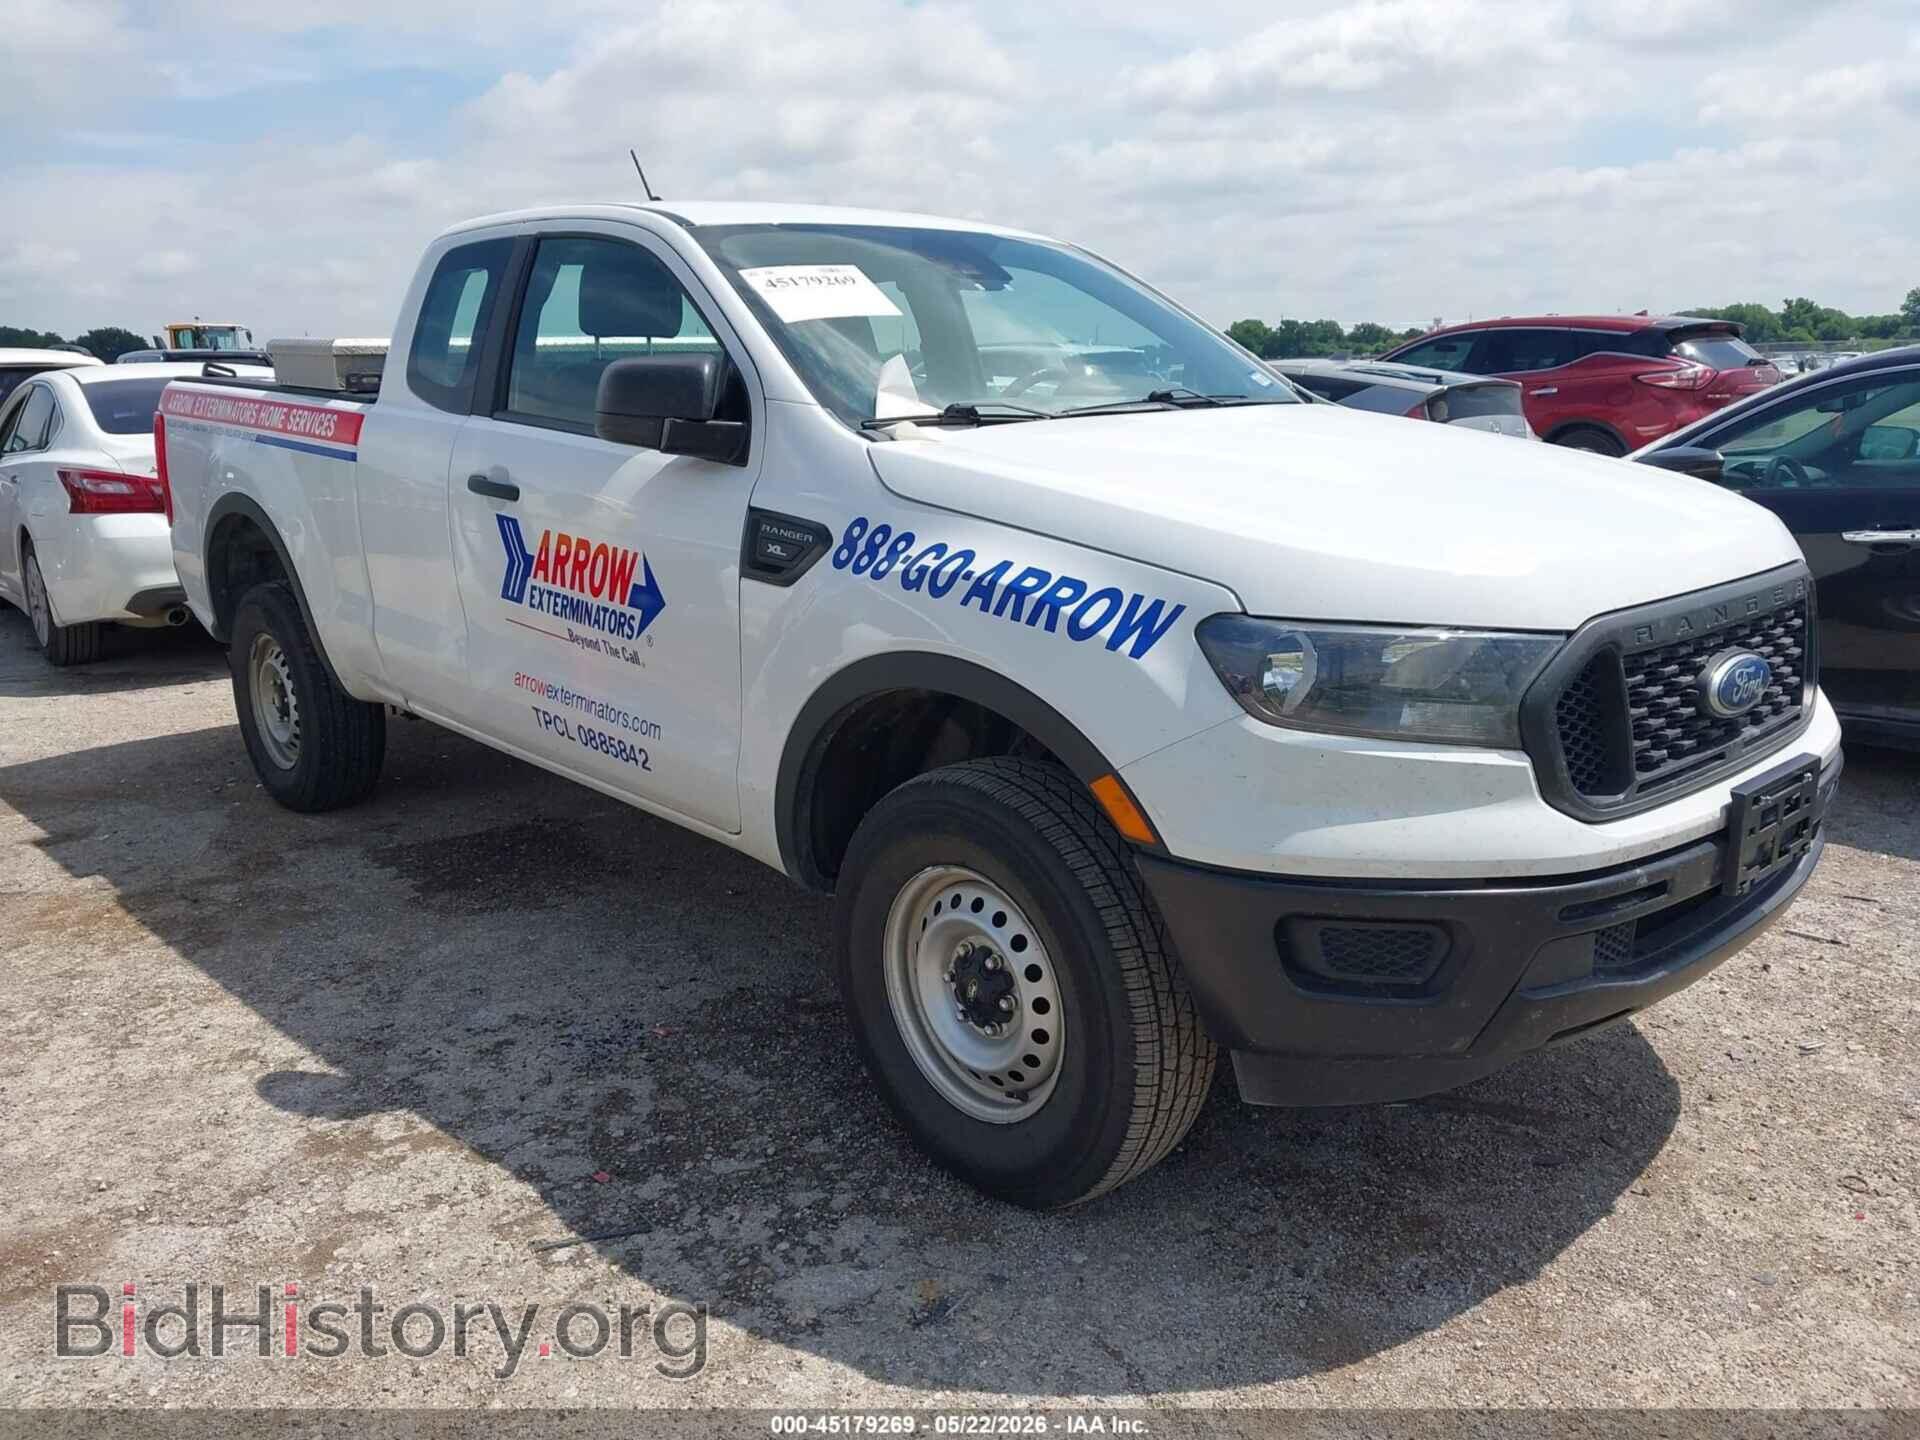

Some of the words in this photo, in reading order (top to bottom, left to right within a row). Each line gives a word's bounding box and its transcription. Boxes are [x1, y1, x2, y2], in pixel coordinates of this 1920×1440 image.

[258, 404, 288, 429] HOME
[287, 408, 338, 437] SERVICES
[761, 523, 814, 543] RANGER
[766, 543, 788, 557] XL
[533, 529, 639, 606] ARROW
[832, 516, 1186, 660] 888-GO-ARROW
[529, 585, 637, 641] EXTERMINATORS
[567, 628, 602, 652] Beyond
[602, 639, 622, 660] The
[514, 671, 662, 740] arrowexterminators.com
[1732, 665, 1765, 703] Ford
[531, 705, 577, 743] TPCL
[577, 724, 653, 772] 0885842
